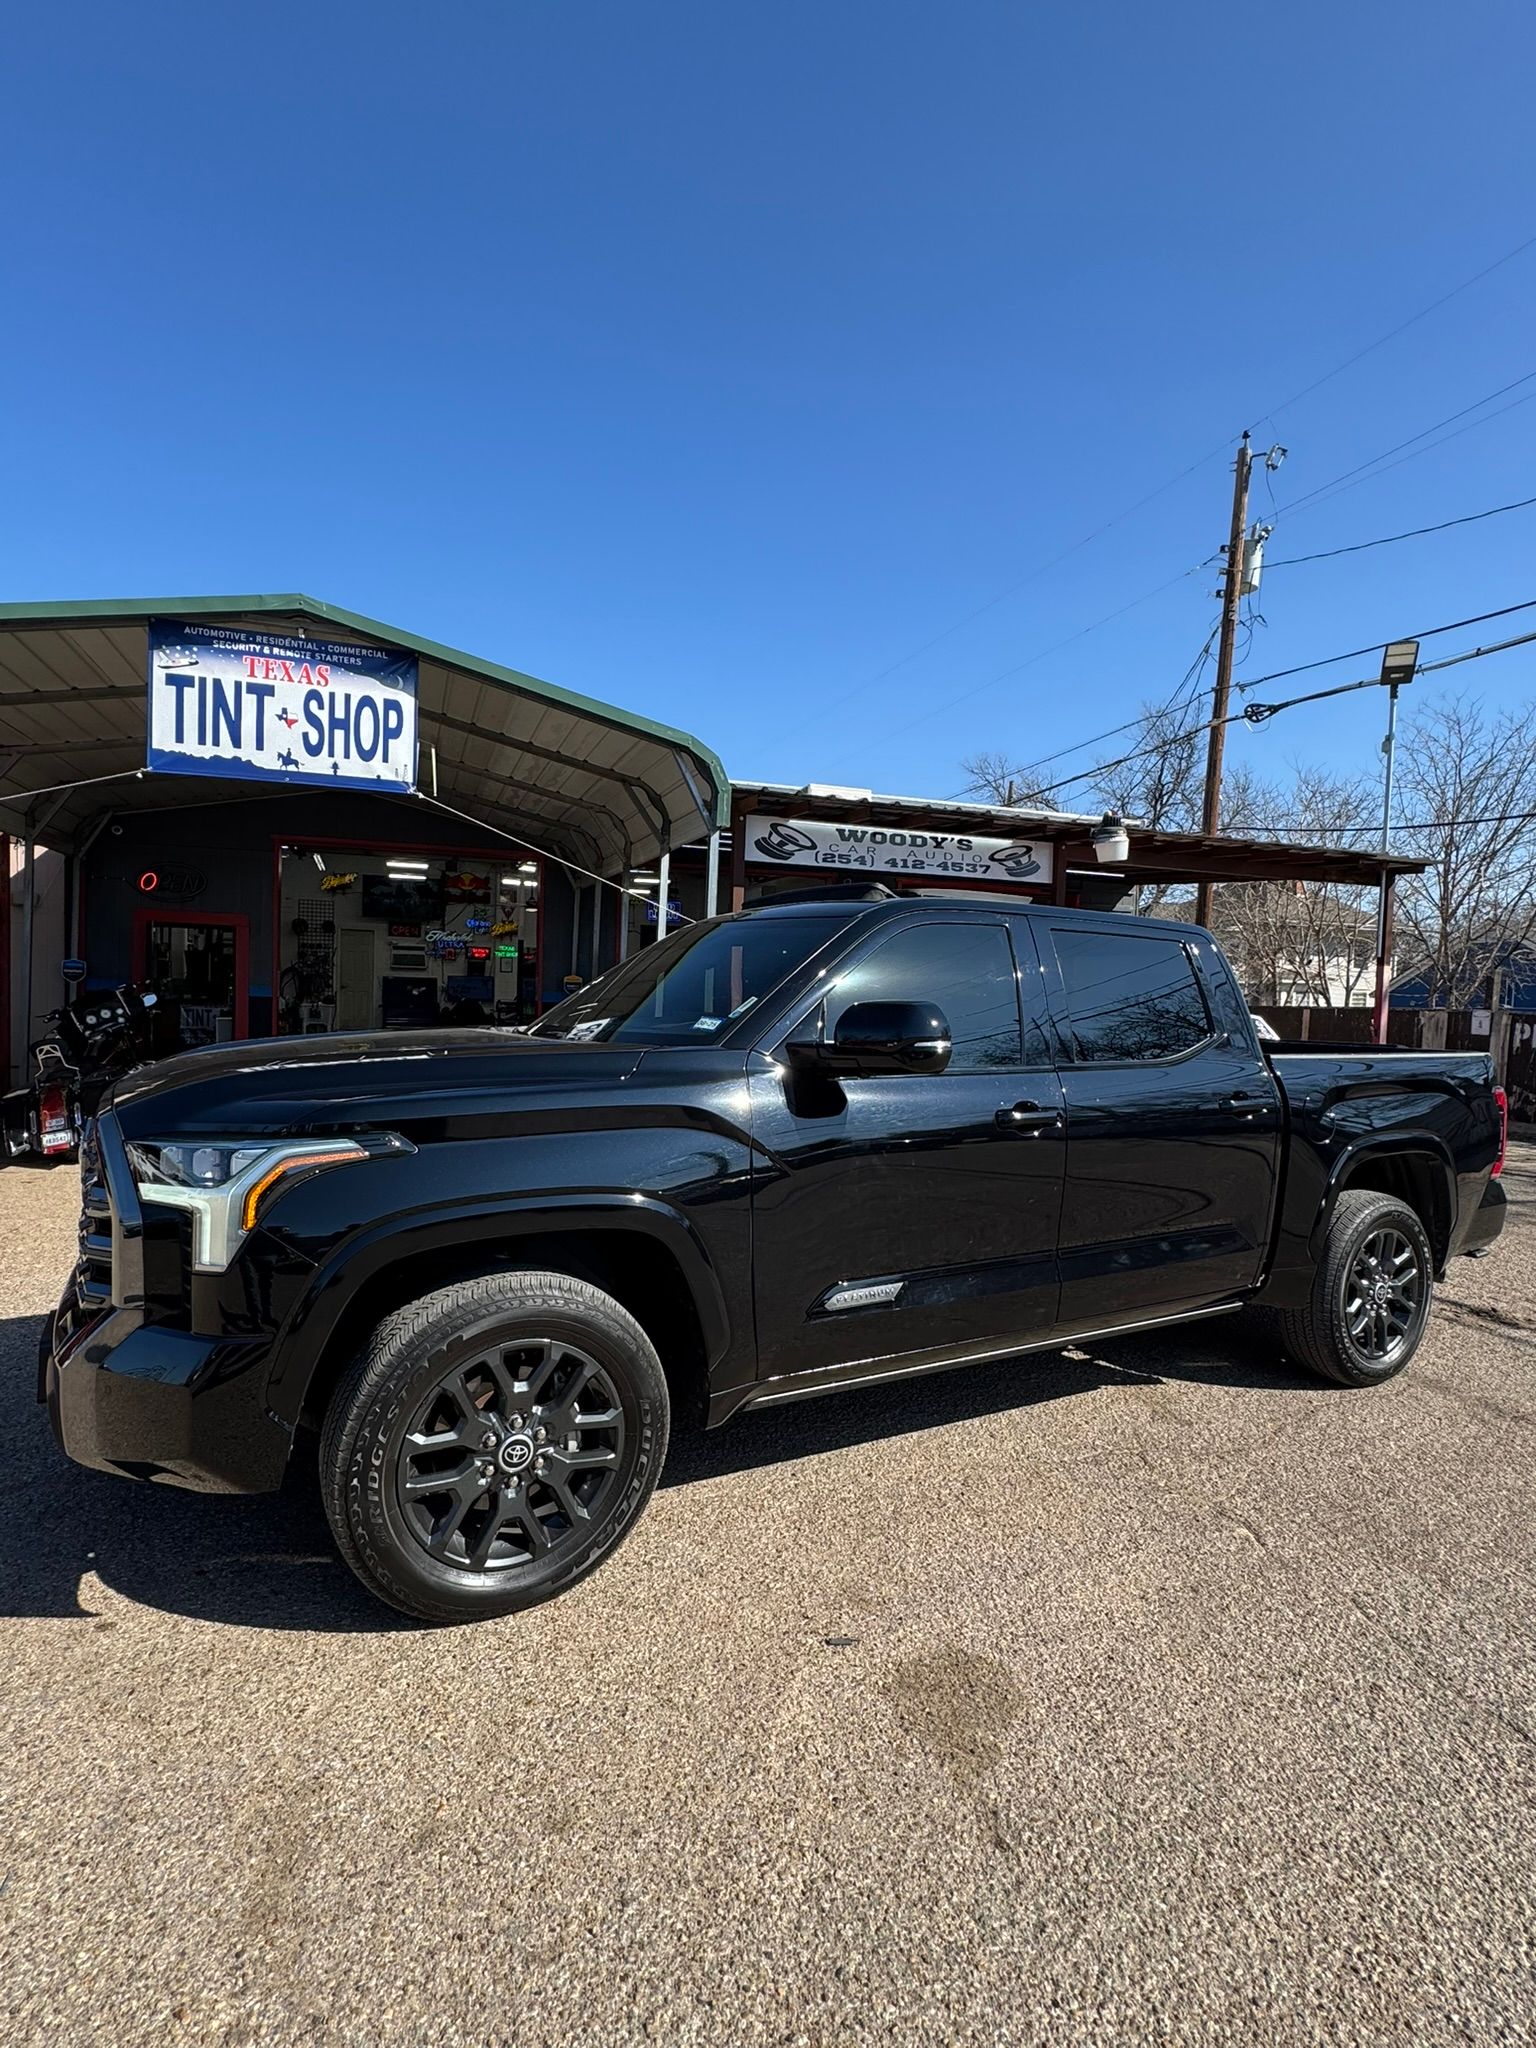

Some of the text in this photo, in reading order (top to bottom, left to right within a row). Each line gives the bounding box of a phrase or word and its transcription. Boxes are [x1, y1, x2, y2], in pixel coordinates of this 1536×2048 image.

[184, 626, 388, 659] AUTOMOTIVE RESIDENTIAL COMMERCIAL
[213, 639, 362, 666] SECURITY & REMOTE STARTERS
[243, 655, 330, 687] TEXAS
[165, 673, 404, 763] TINT SHOP
[836, 828, 973, 851] WOODY'S
[814, 850, 990, 875] (254) 412-4537
[829, 843, 982, 863] CAR AUDIO
[391, 926, 419, 936] OPEN
[437, 940, 465, 949] ULTRA
[184, 1008, 212, 1027] TINT
[836, 1287, 894, 1304] PLATINUM
